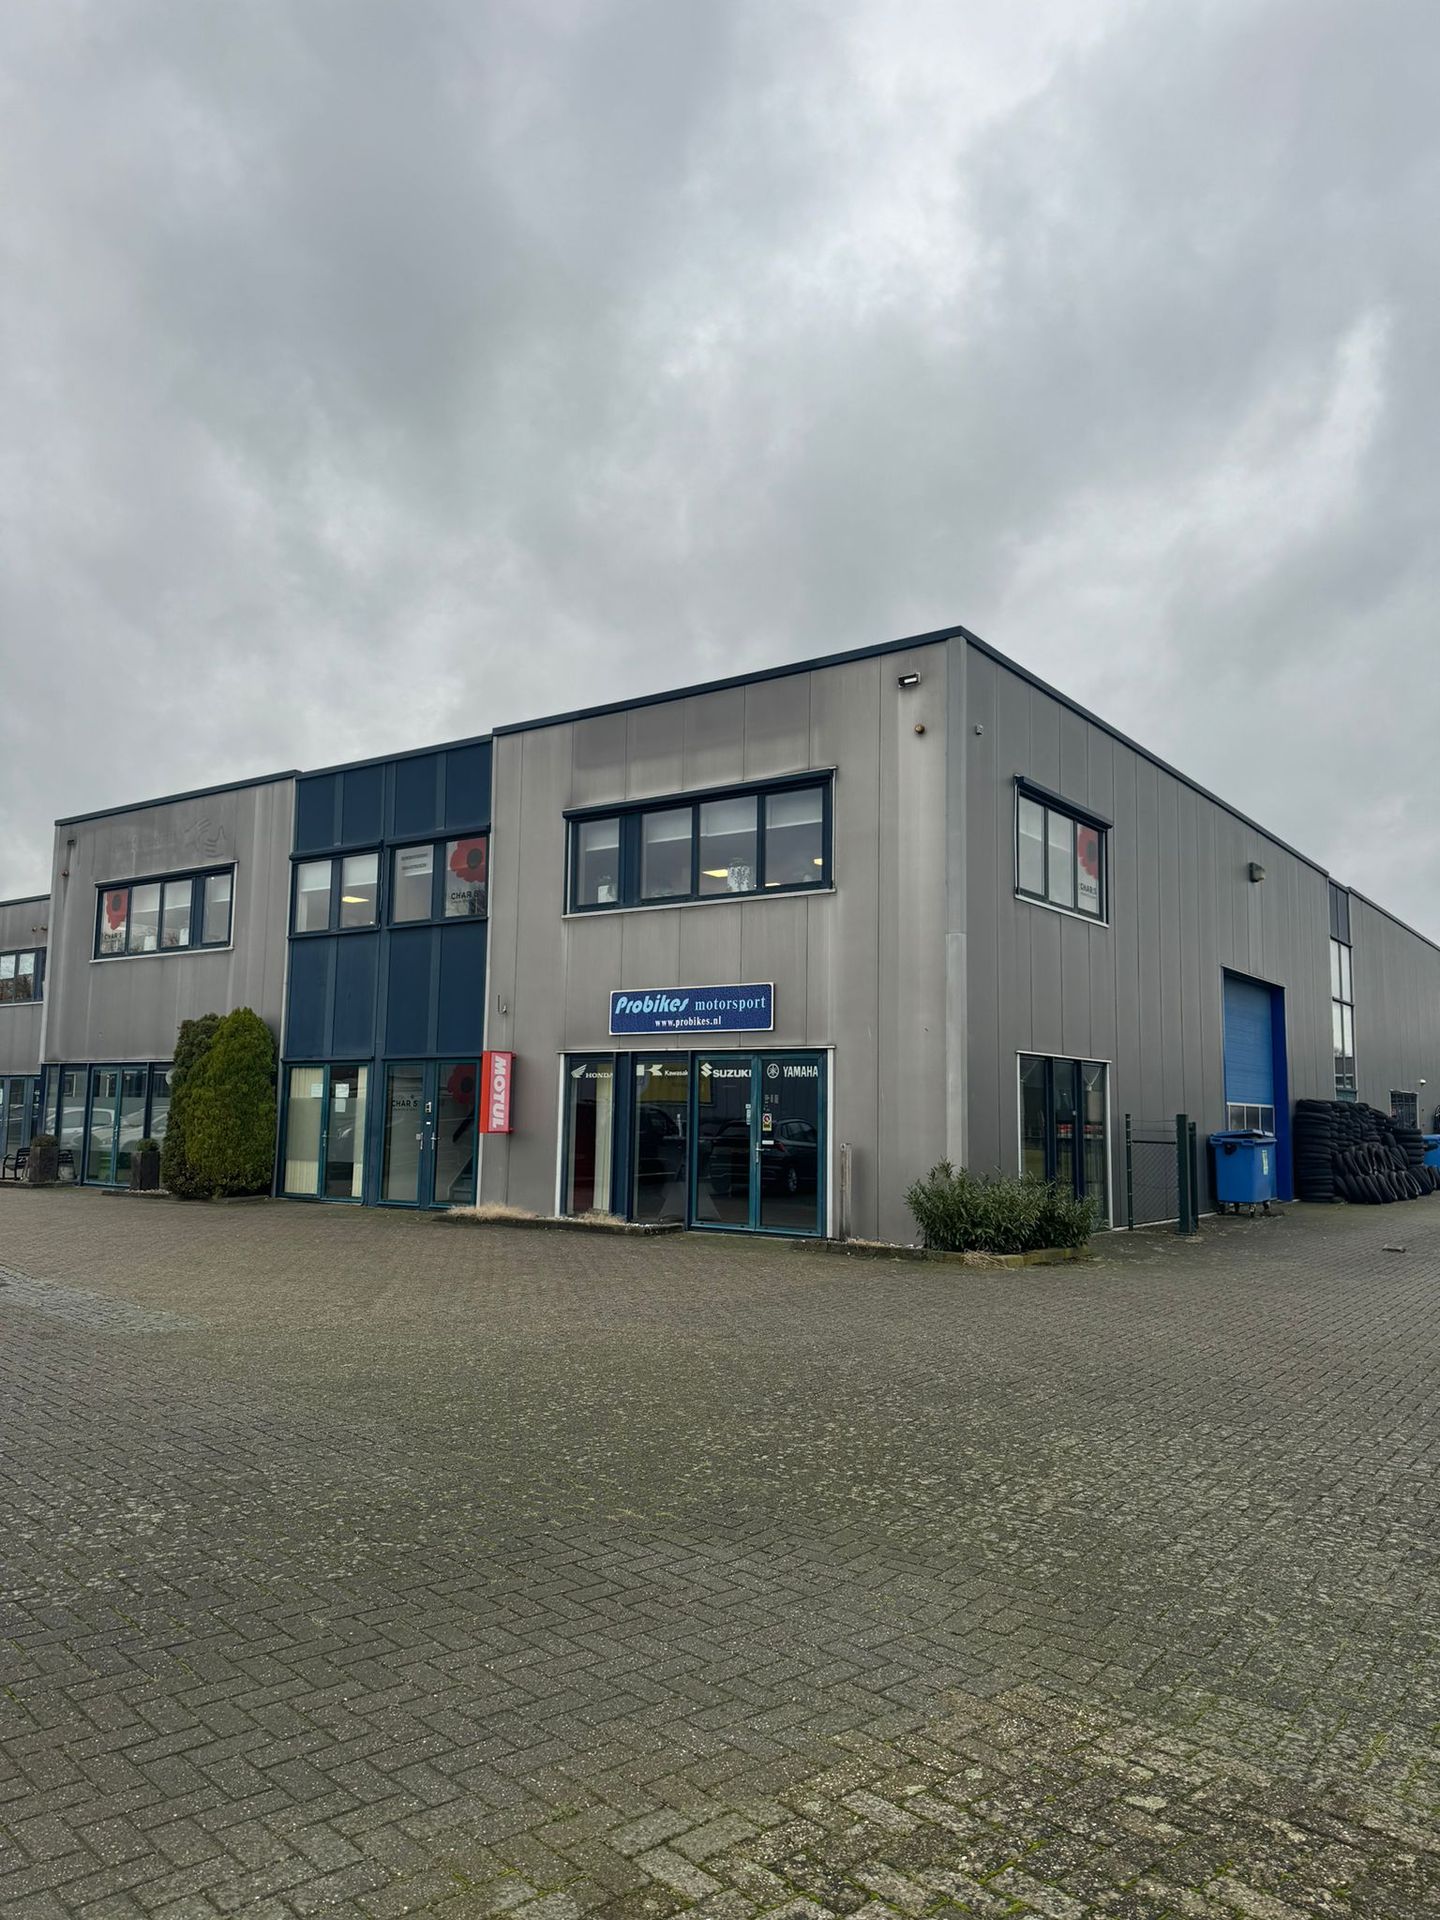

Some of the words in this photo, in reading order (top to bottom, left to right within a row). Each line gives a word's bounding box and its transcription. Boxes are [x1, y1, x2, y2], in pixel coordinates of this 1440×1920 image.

[615, 994, 690, 1015] Probikes
[694, 995, 767, 1012] motorsport
[655, 1016, 722, 1029] www.probikes.nl
[712, 1069, 752, 1078] SUZUKI
[783, 1065, 819, 1077] YAMAHA
[491, 1055, 507, 1129] MOTUL
